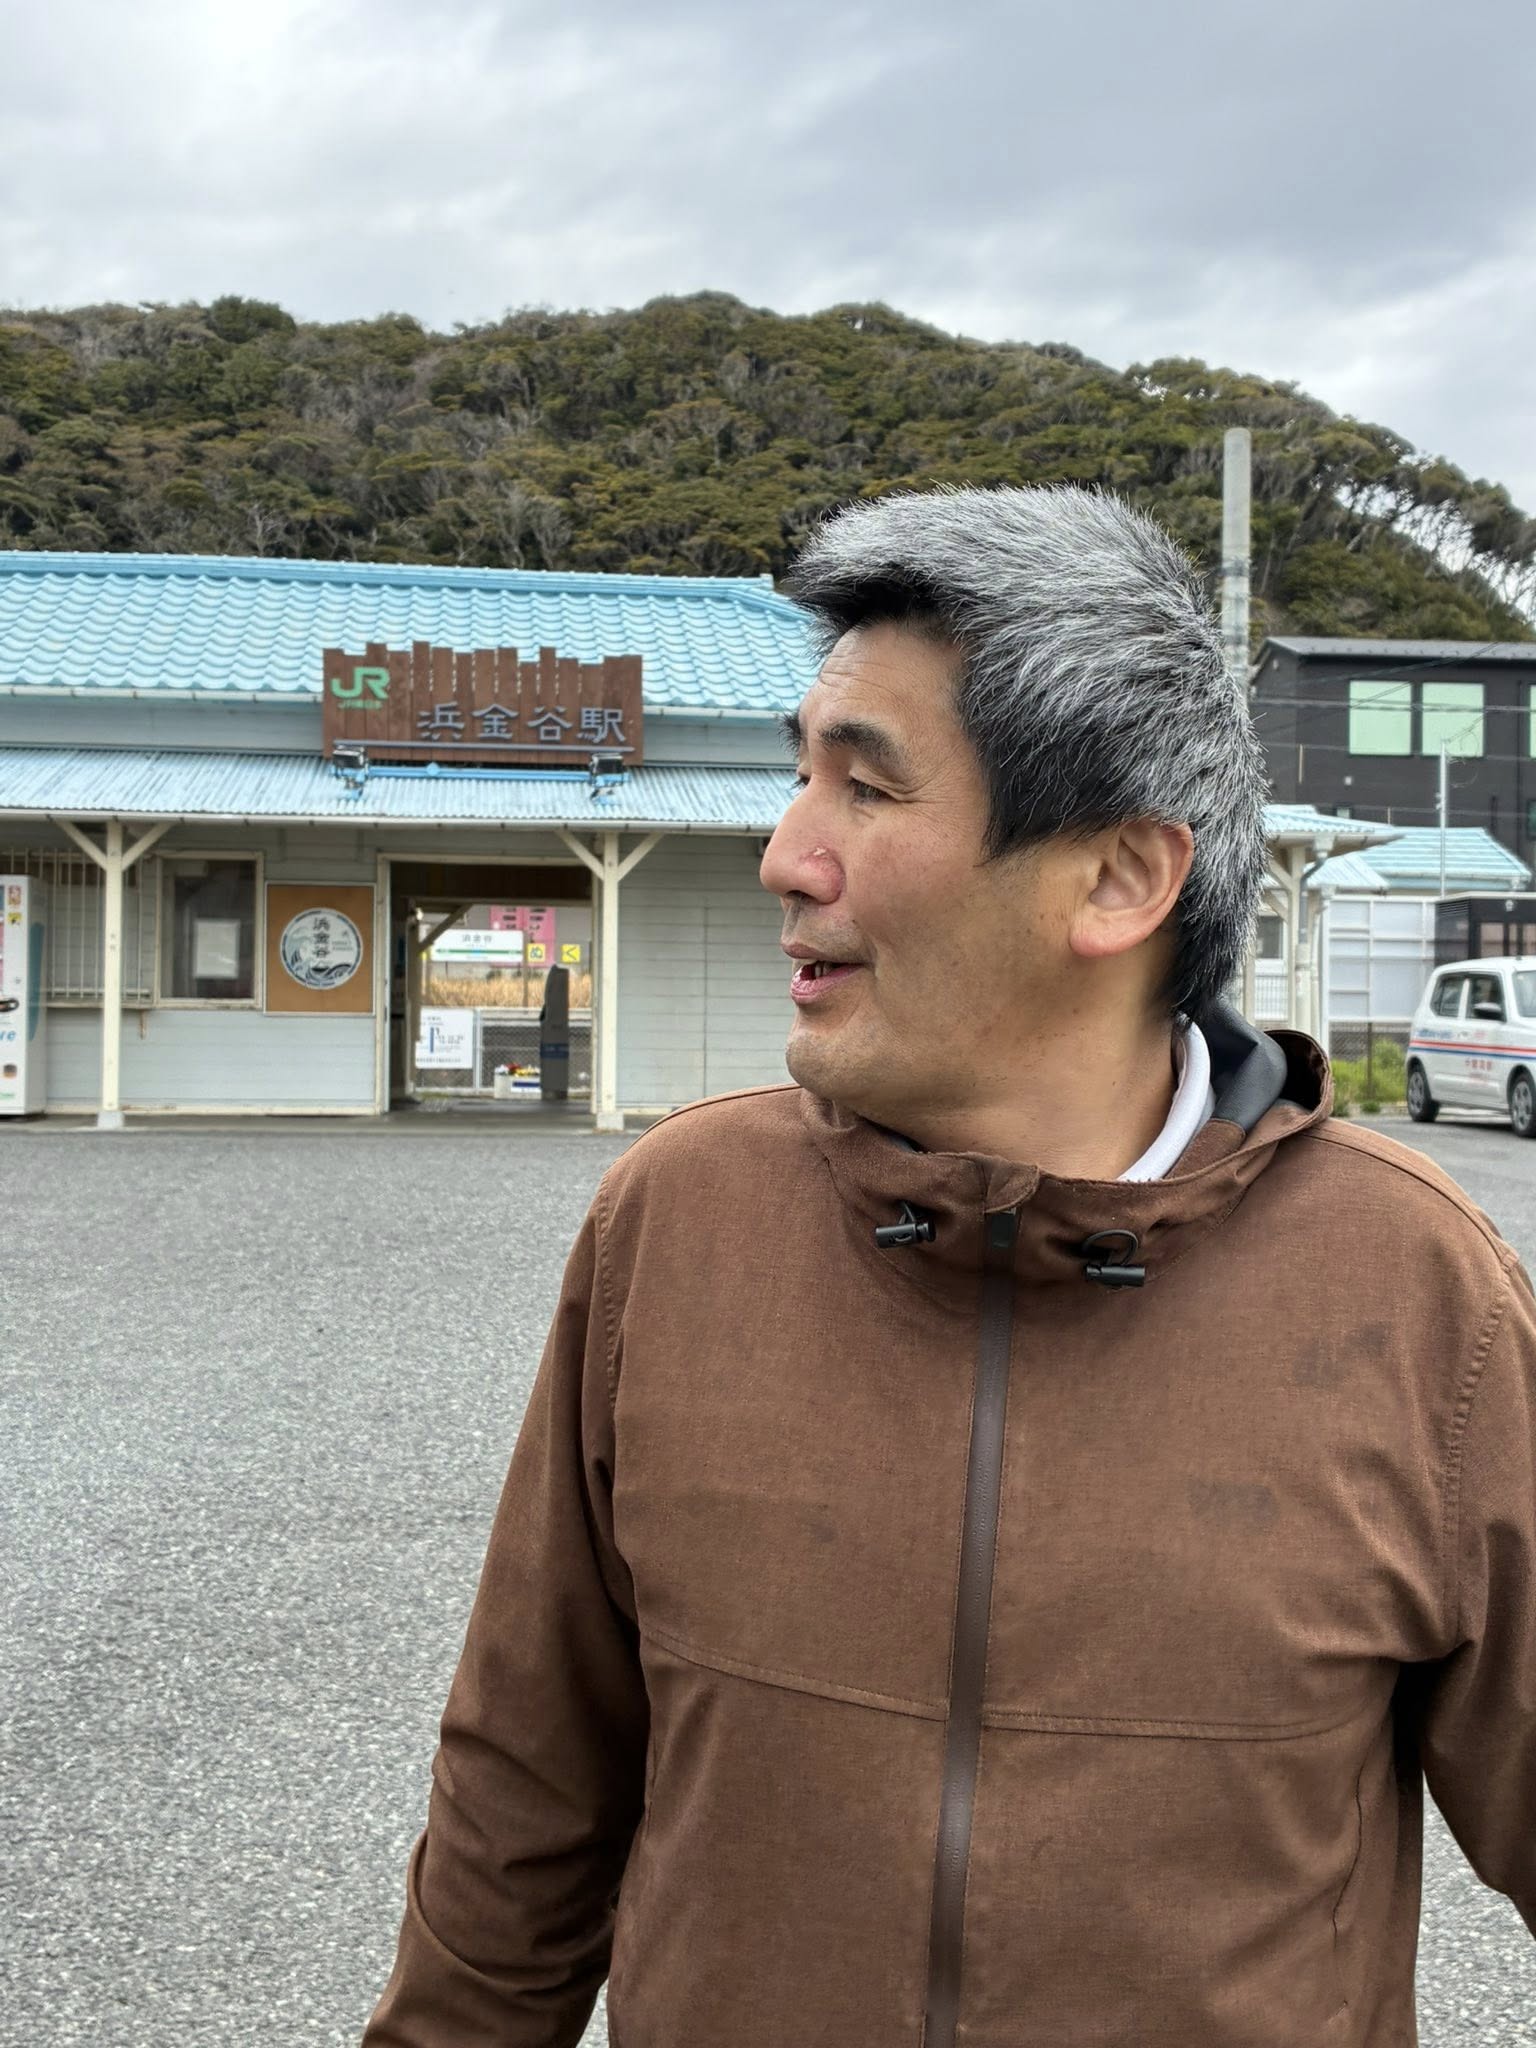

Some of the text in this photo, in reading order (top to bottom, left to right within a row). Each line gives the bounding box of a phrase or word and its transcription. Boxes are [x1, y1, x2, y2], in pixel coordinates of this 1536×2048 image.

[330, 666, 390, 700] JR
[416, 701, 626, 743] 浜金谷駅
